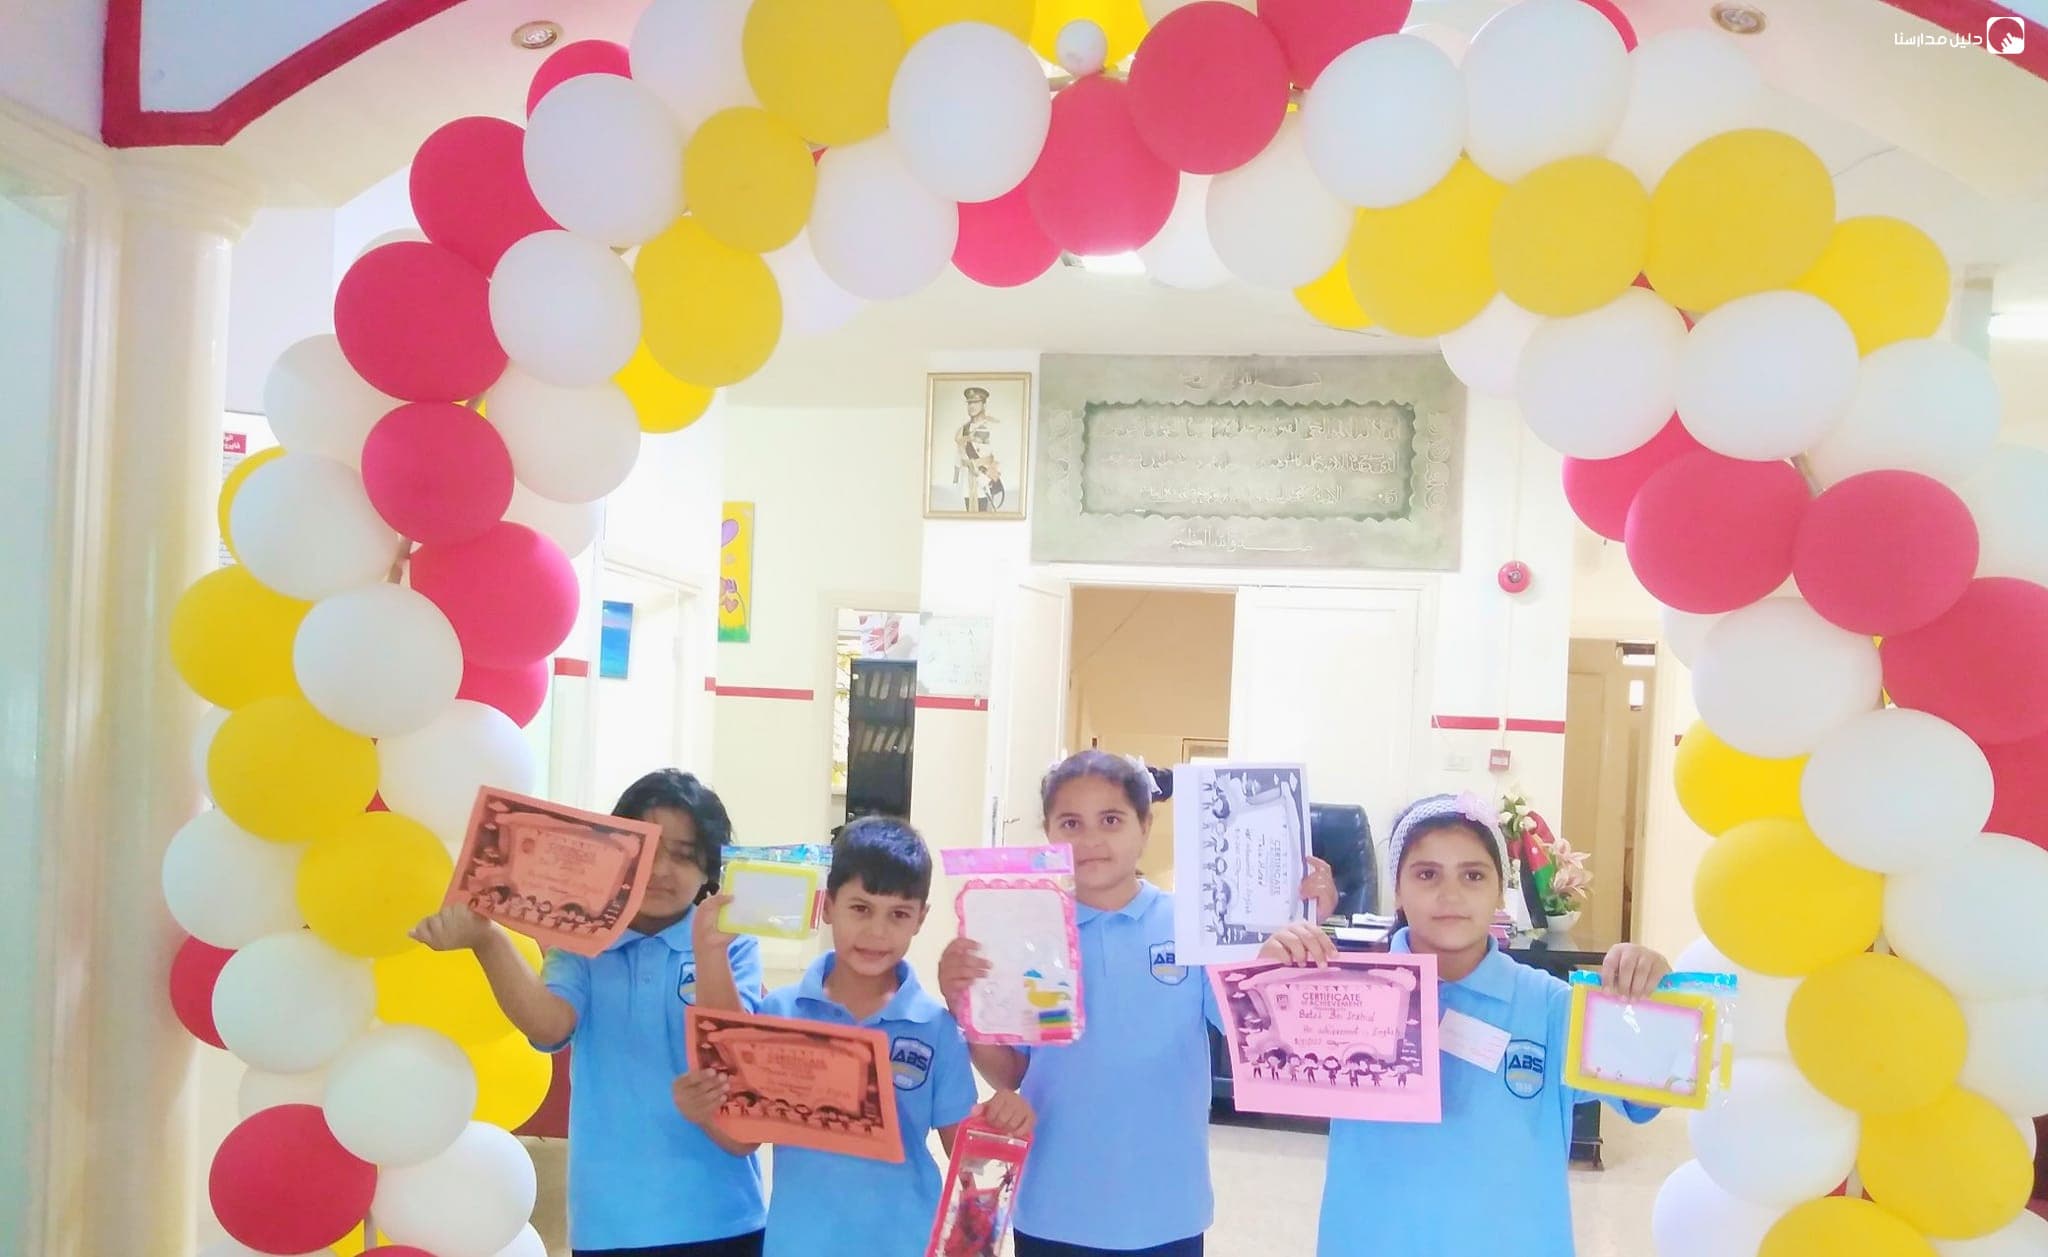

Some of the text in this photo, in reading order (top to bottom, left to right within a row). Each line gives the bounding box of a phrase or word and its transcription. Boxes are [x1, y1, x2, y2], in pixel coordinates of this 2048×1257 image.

[1153, 952, 1176, 965] AB
[1302, 992, 1361, 1001] CERTIFICATE
[893, 1049, 928, 1071] ABS
[1508, 1054, 1544, 1074] ABS
